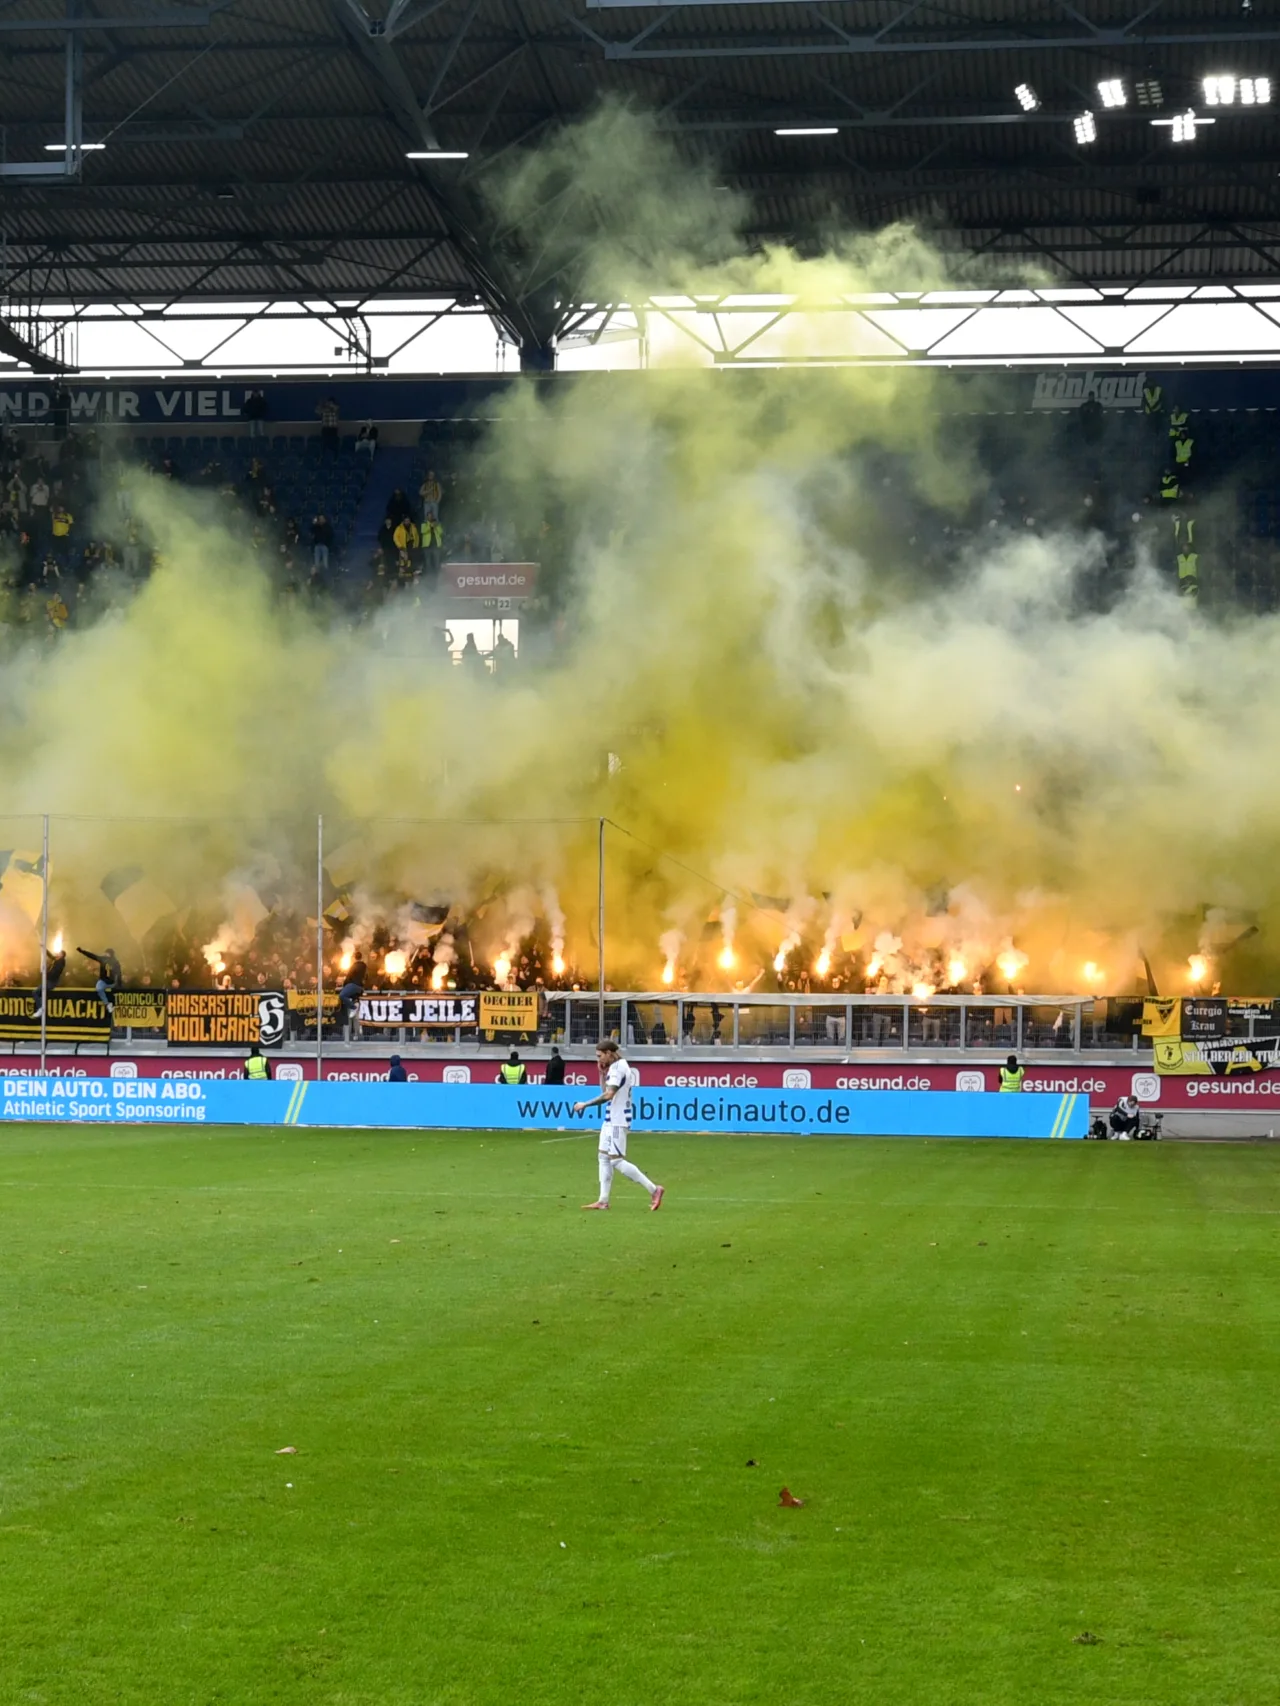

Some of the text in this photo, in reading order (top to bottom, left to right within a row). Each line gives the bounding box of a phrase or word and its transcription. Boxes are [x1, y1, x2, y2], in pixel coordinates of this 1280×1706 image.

[1034, 372, 1147, 405] trinkgut
[71, 390, 141, 417] WIR
[457, 574, 526, 588] gesund.de
[168, 994, 262, 1016] KAISERSTADT
[484, 995, 533, 1006] OECHER
[408, 999, 476, 1022] JEILE
[168, 1016, 261, 1042] HOOLIGANS
[491, 1015, 525, 1026] KRAU
[4, 1080, 207, 1099] DEIN AUTO. DEIN ABO.
[664, 1073, 758, 1088] gesund.de
[836, 1075, 931, 1090] gesund.de
[1023, 1077, 1107, 1093] esund.de
[4, 1101, 206, 1122] Athletic Sport Sponsoring
